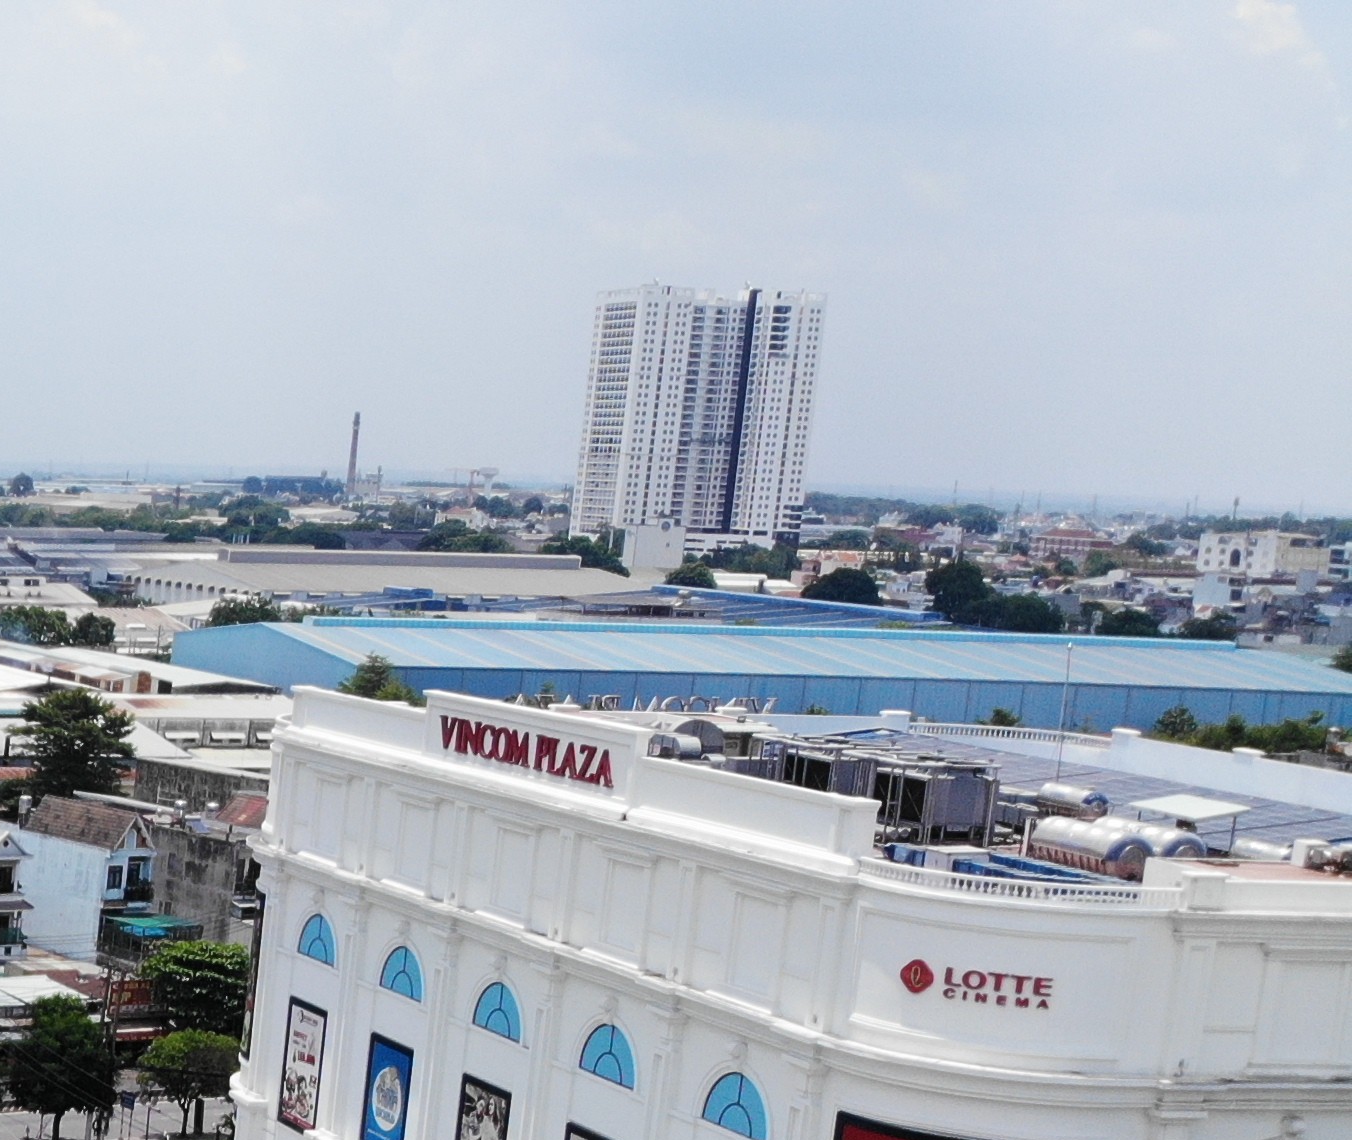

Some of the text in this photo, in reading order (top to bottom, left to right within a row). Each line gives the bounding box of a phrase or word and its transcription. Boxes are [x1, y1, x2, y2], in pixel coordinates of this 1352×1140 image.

[440, 715, 614, 788] VINCOM PLAZA
[944, 966, 1054, 997] LOTTE
[942, 988, 1049, 1010] CINEMA
